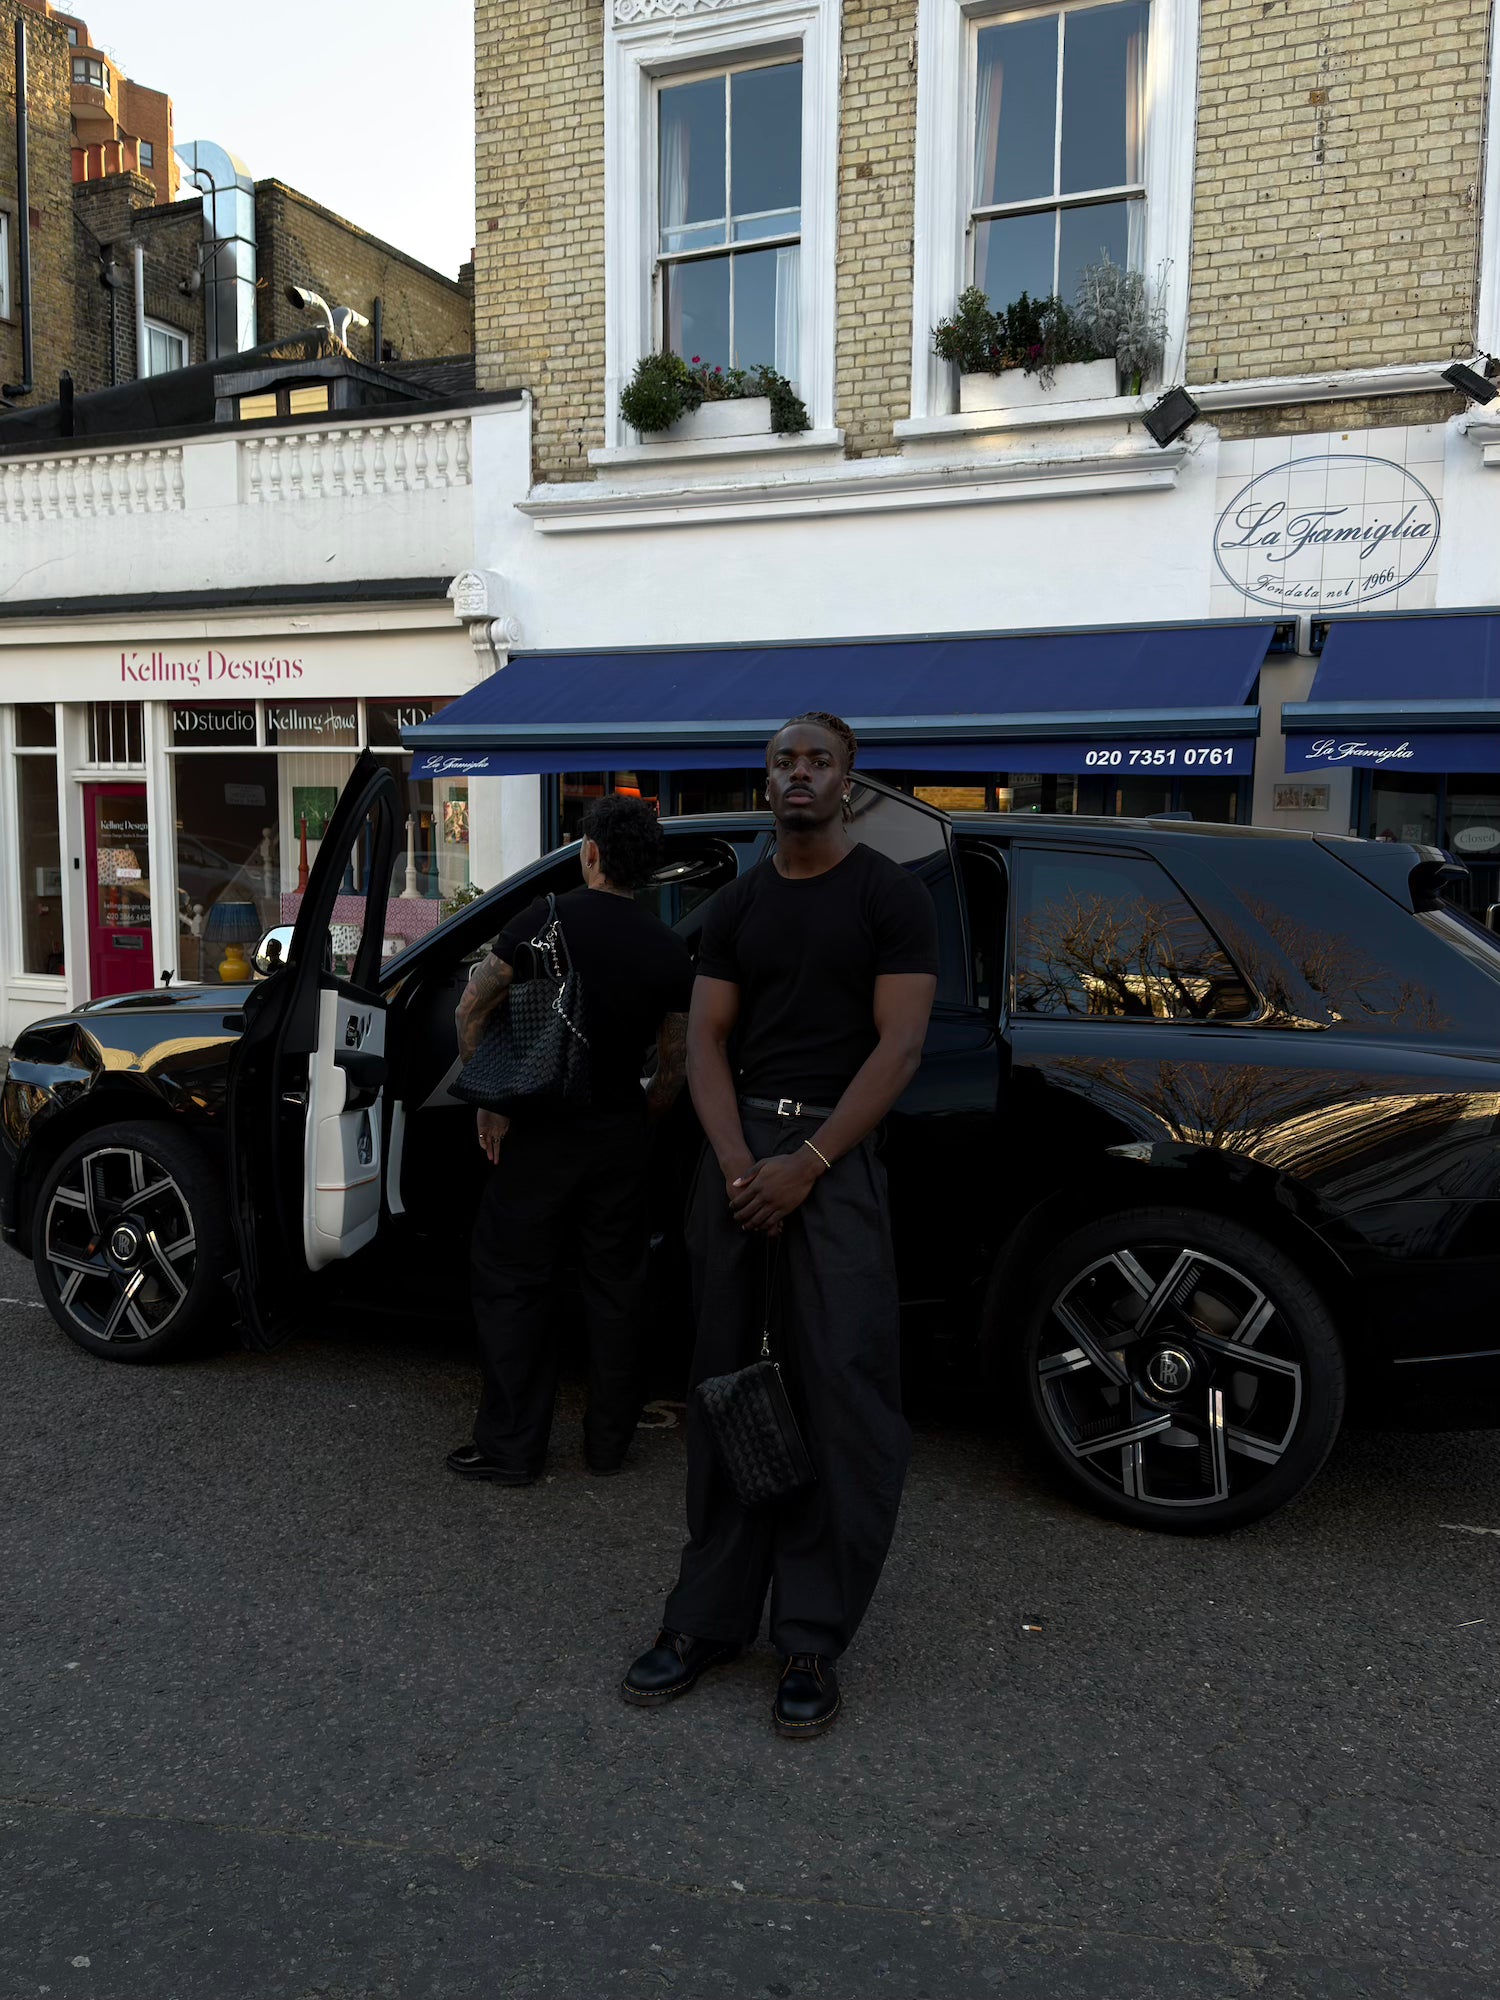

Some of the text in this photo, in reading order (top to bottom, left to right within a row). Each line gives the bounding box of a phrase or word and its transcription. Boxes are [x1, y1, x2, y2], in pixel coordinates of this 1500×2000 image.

[1220, 501, 1432, 561] La Famiglia
[1246, 566, 1395, 598] Fondata nel 1966
[121, 650, 303, 687] Kelling Designs
[172, 710, 255, 731] KDstudio
[268, 705, 356, 736] Kelling Home
[1085, 748, 1233, 765] 020 7351 0761
[1304, 739, 1415, 764] La Famiglia
[421, 755, 489, 773] La Famiglia
[100, 819, 148, 831] Kelling Design
[1460, 832, 1496, 843] Closed
